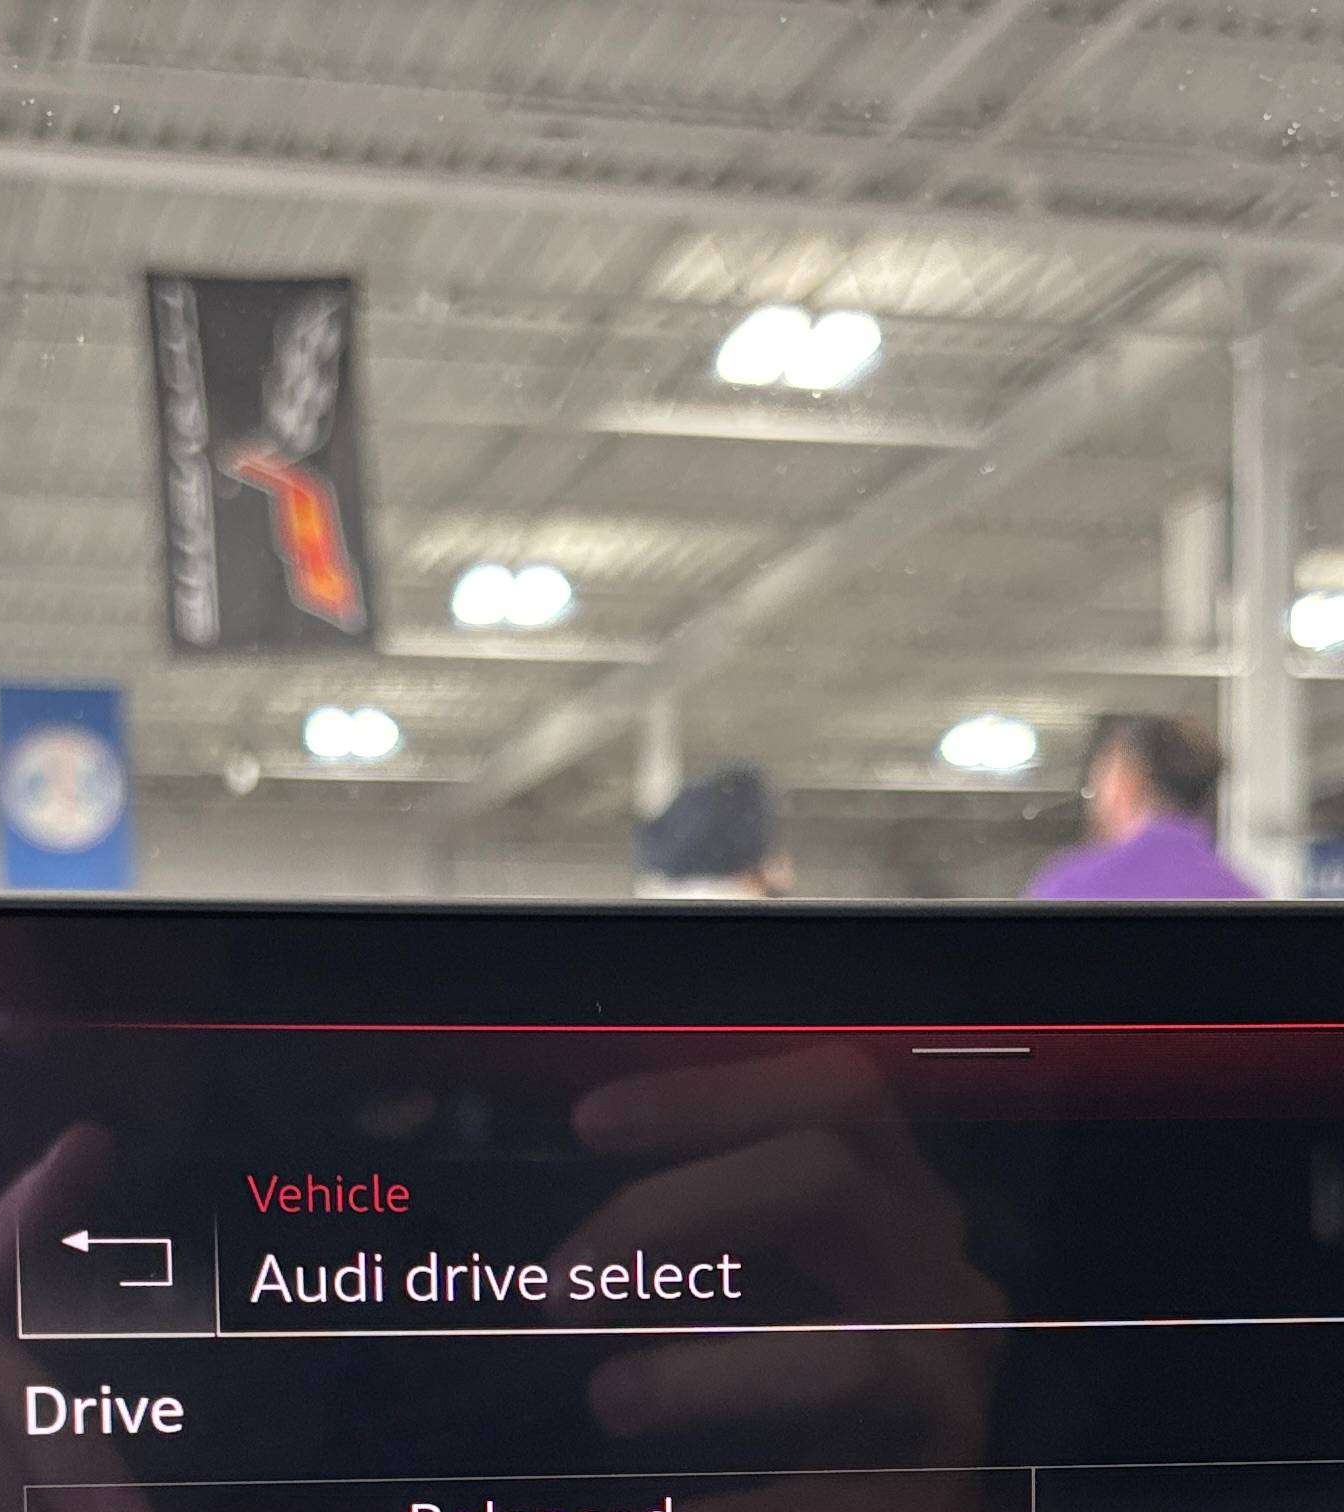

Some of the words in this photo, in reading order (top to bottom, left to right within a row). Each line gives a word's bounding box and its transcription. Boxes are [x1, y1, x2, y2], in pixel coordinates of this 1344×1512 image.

[248, 1174, 410, 1213] Vehicle
[251, 1252, 384, 1303] Audi
[405, 1250, 549, 1302] drive
[568, 1249, 742, 1301] select
[24, 1385, 184, 1436] Drive
